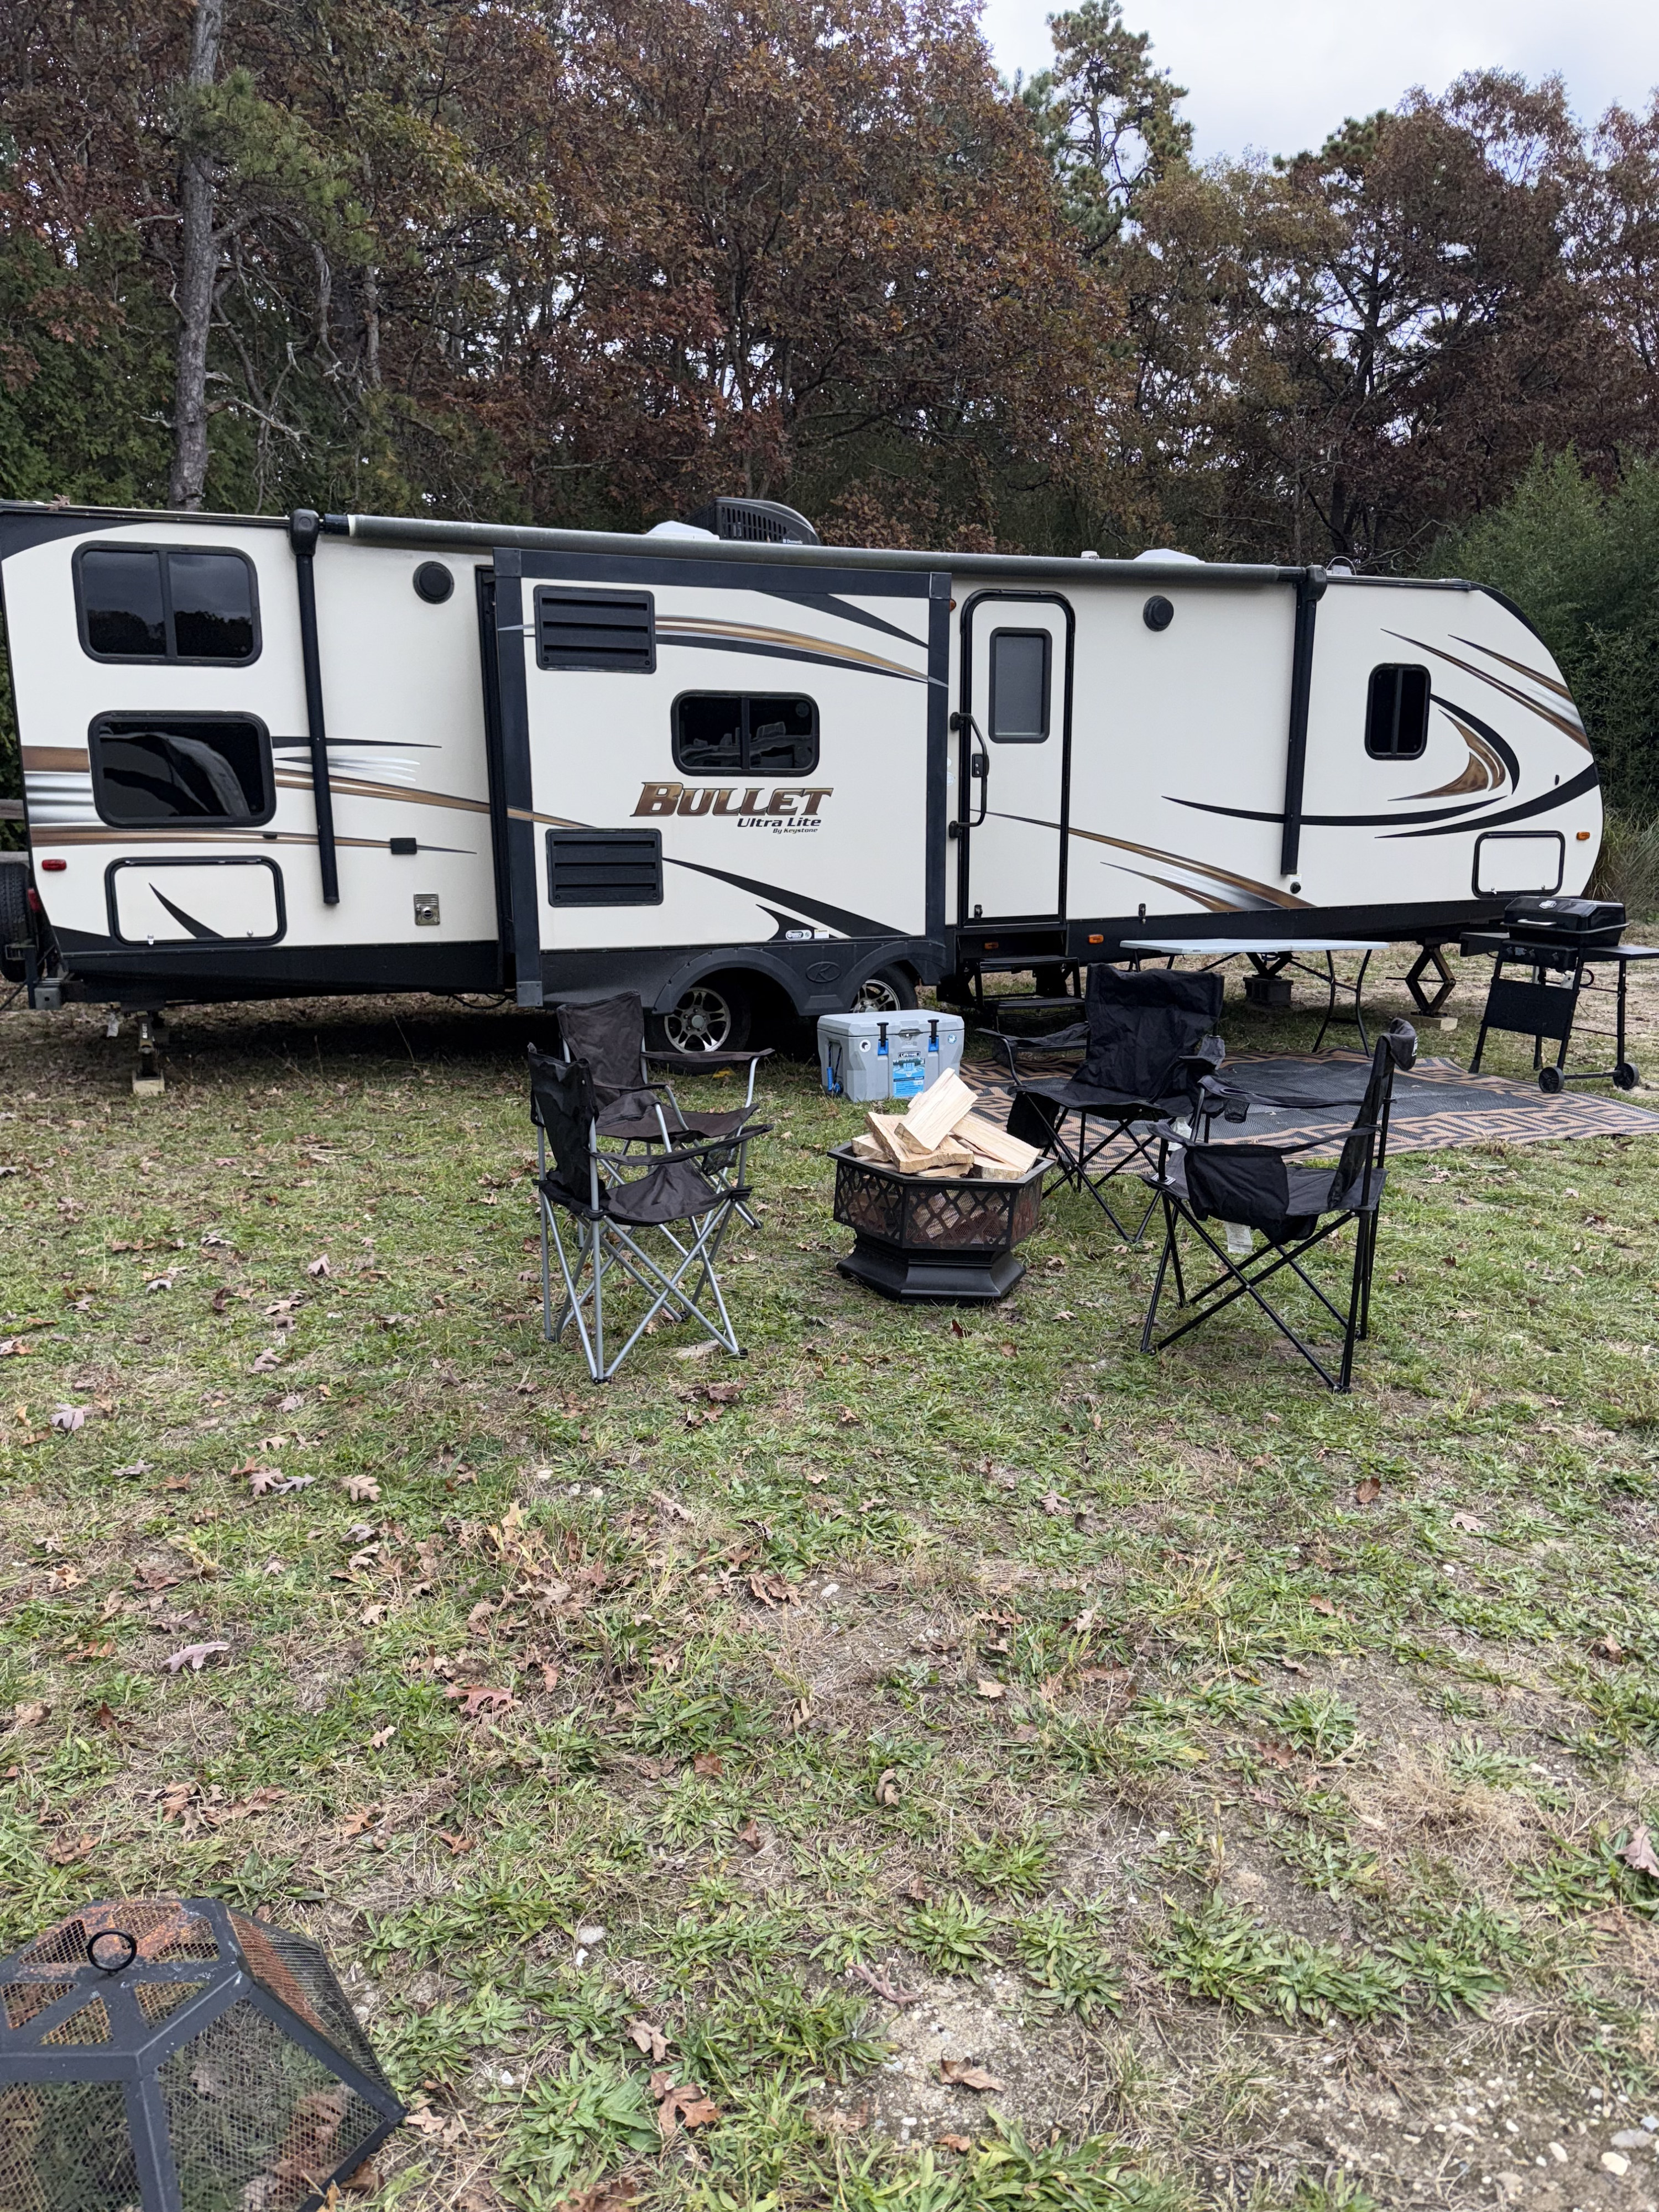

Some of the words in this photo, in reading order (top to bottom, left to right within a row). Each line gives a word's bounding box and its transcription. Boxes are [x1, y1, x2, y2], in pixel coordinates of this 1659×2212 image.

[629, 782, 834, 817] BULLET
[737, 818, 782, 827] Ultra
[787, 817, 822, 827] Lite
